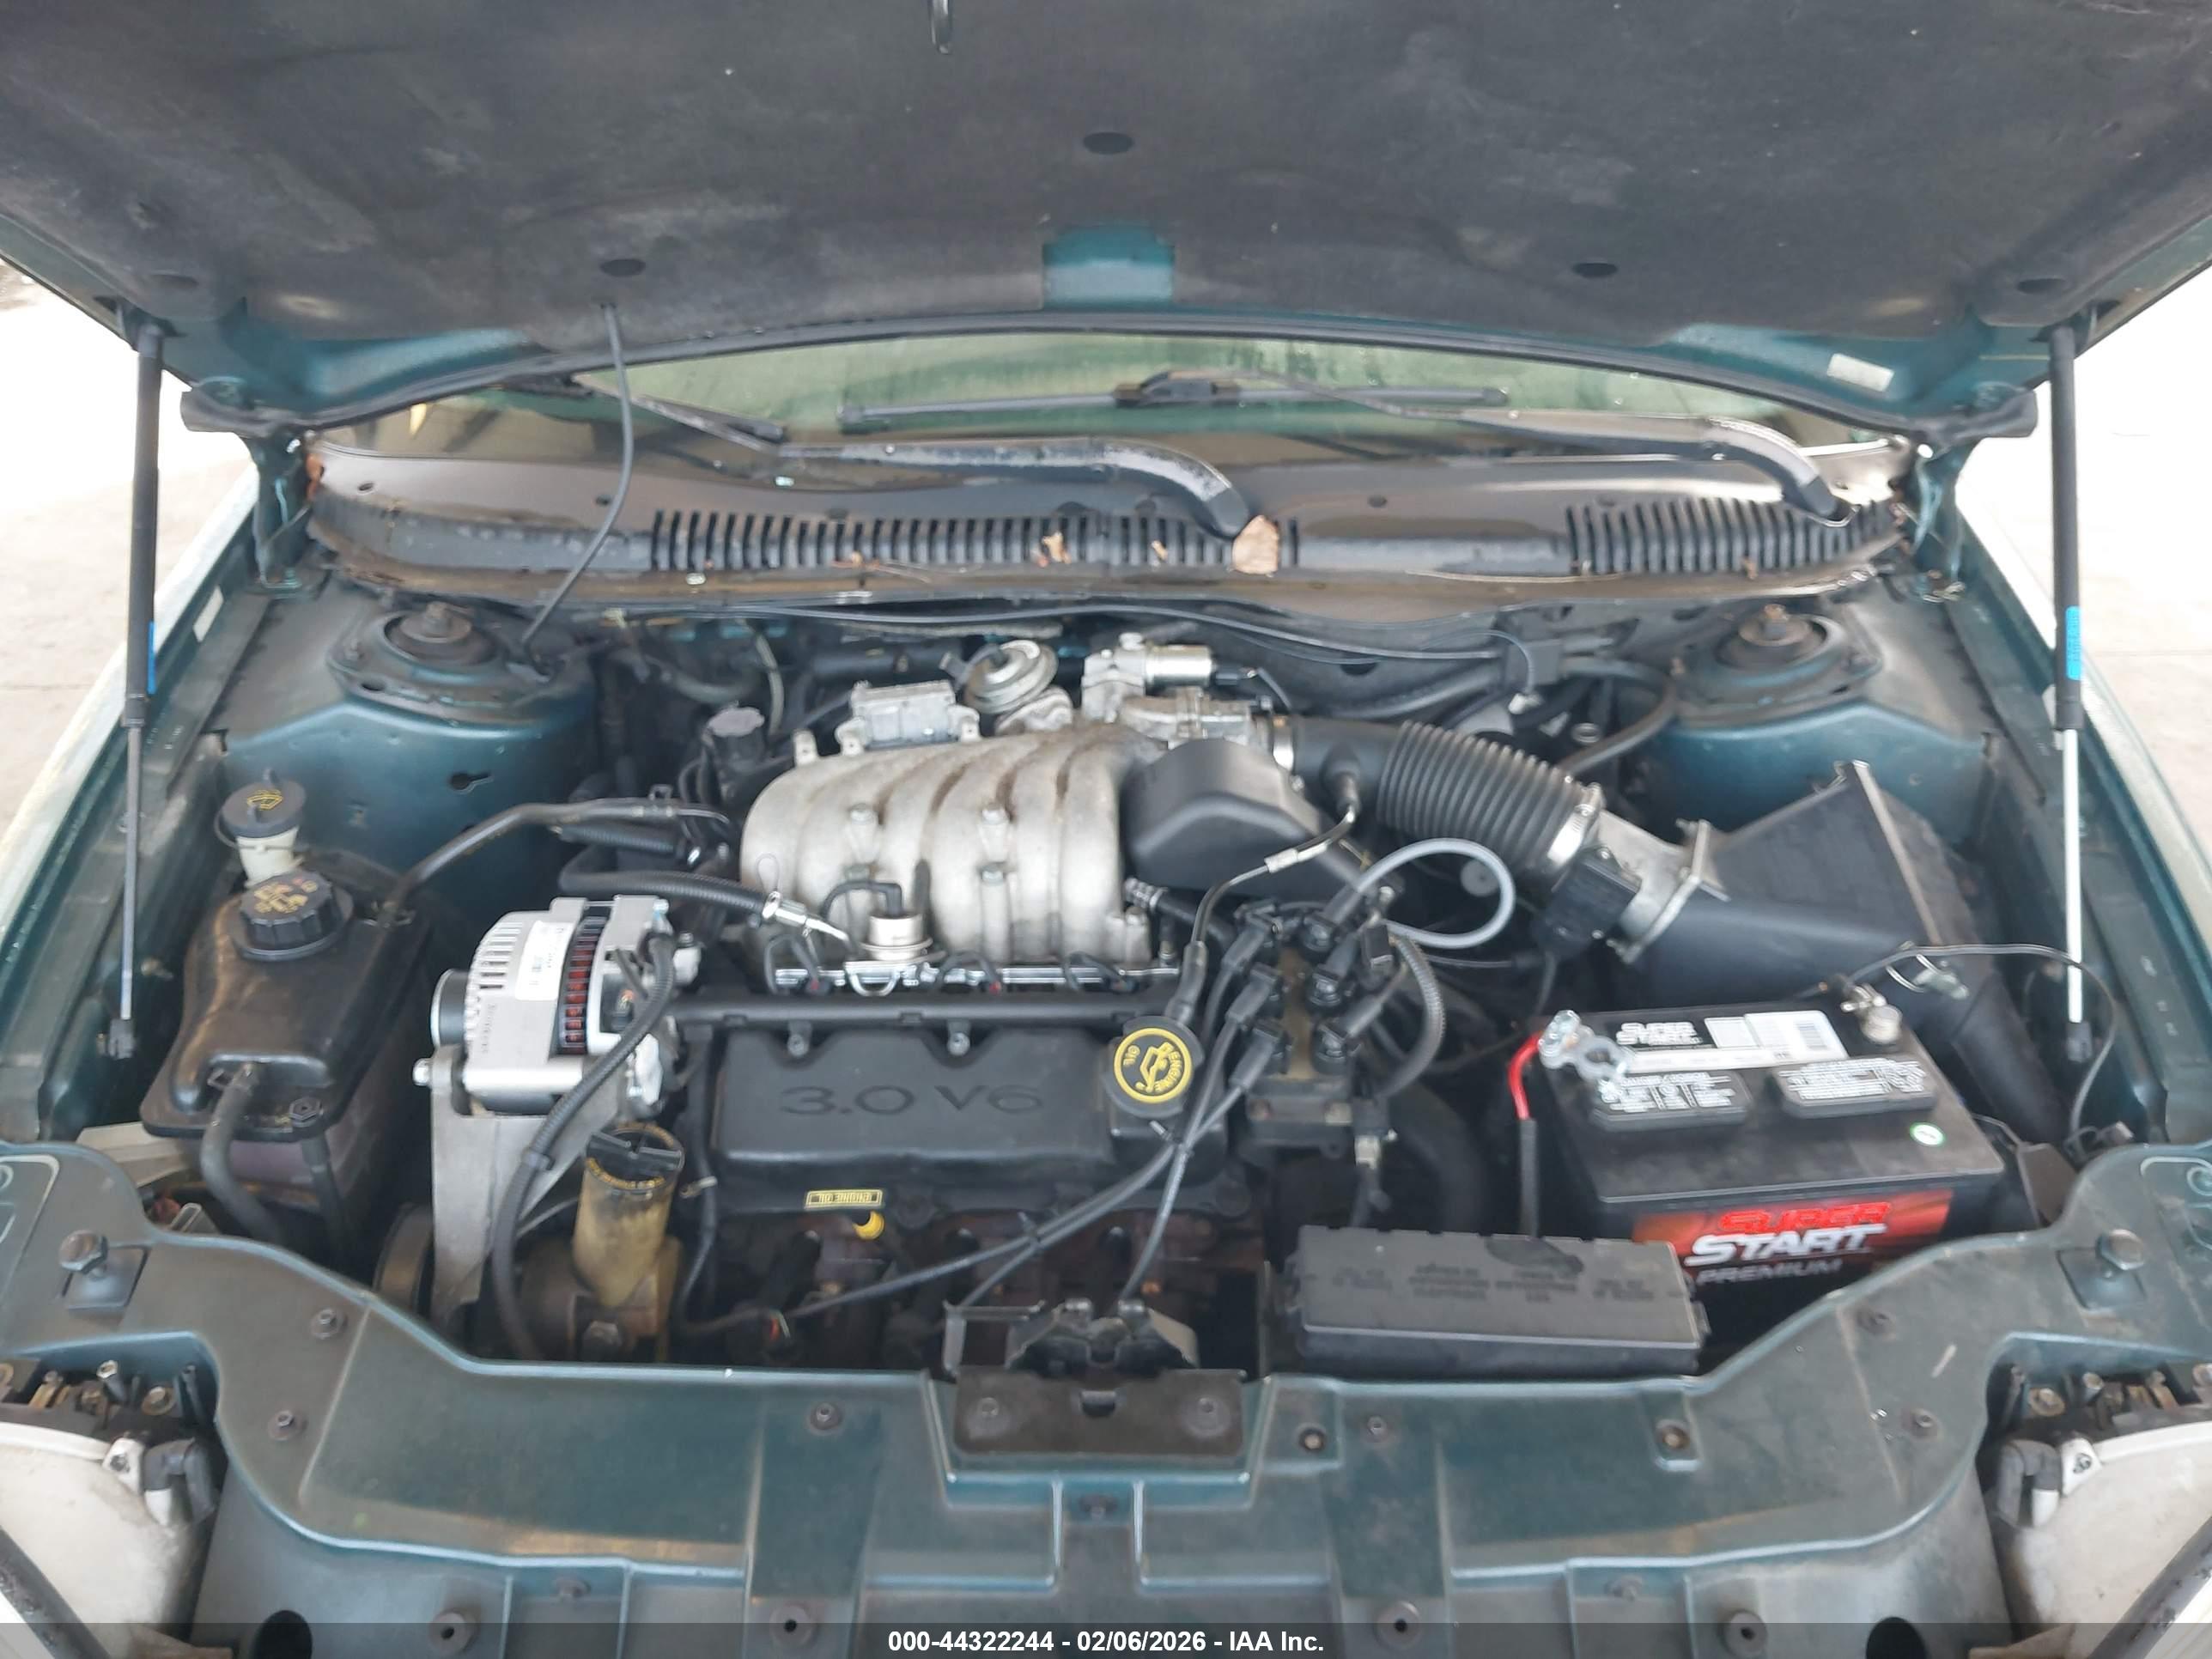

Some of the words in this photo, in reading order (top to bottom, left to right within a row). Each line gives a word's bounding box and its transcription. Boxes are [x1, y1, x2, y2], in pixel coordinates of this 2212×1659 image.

[1123, 1045, 1141, 1066] OIL
[1154, 1050, 1182, 1092] ENGINE
[780, 1085, 915, 1115] 3.0
[933, 1084, 1042, 1115] V6
[1720, 1202, 1891, 1235] SUPER
[1684, 1224, 1887, 1267] START
[1697, 1257, 1843, 1286] PREMIUM
